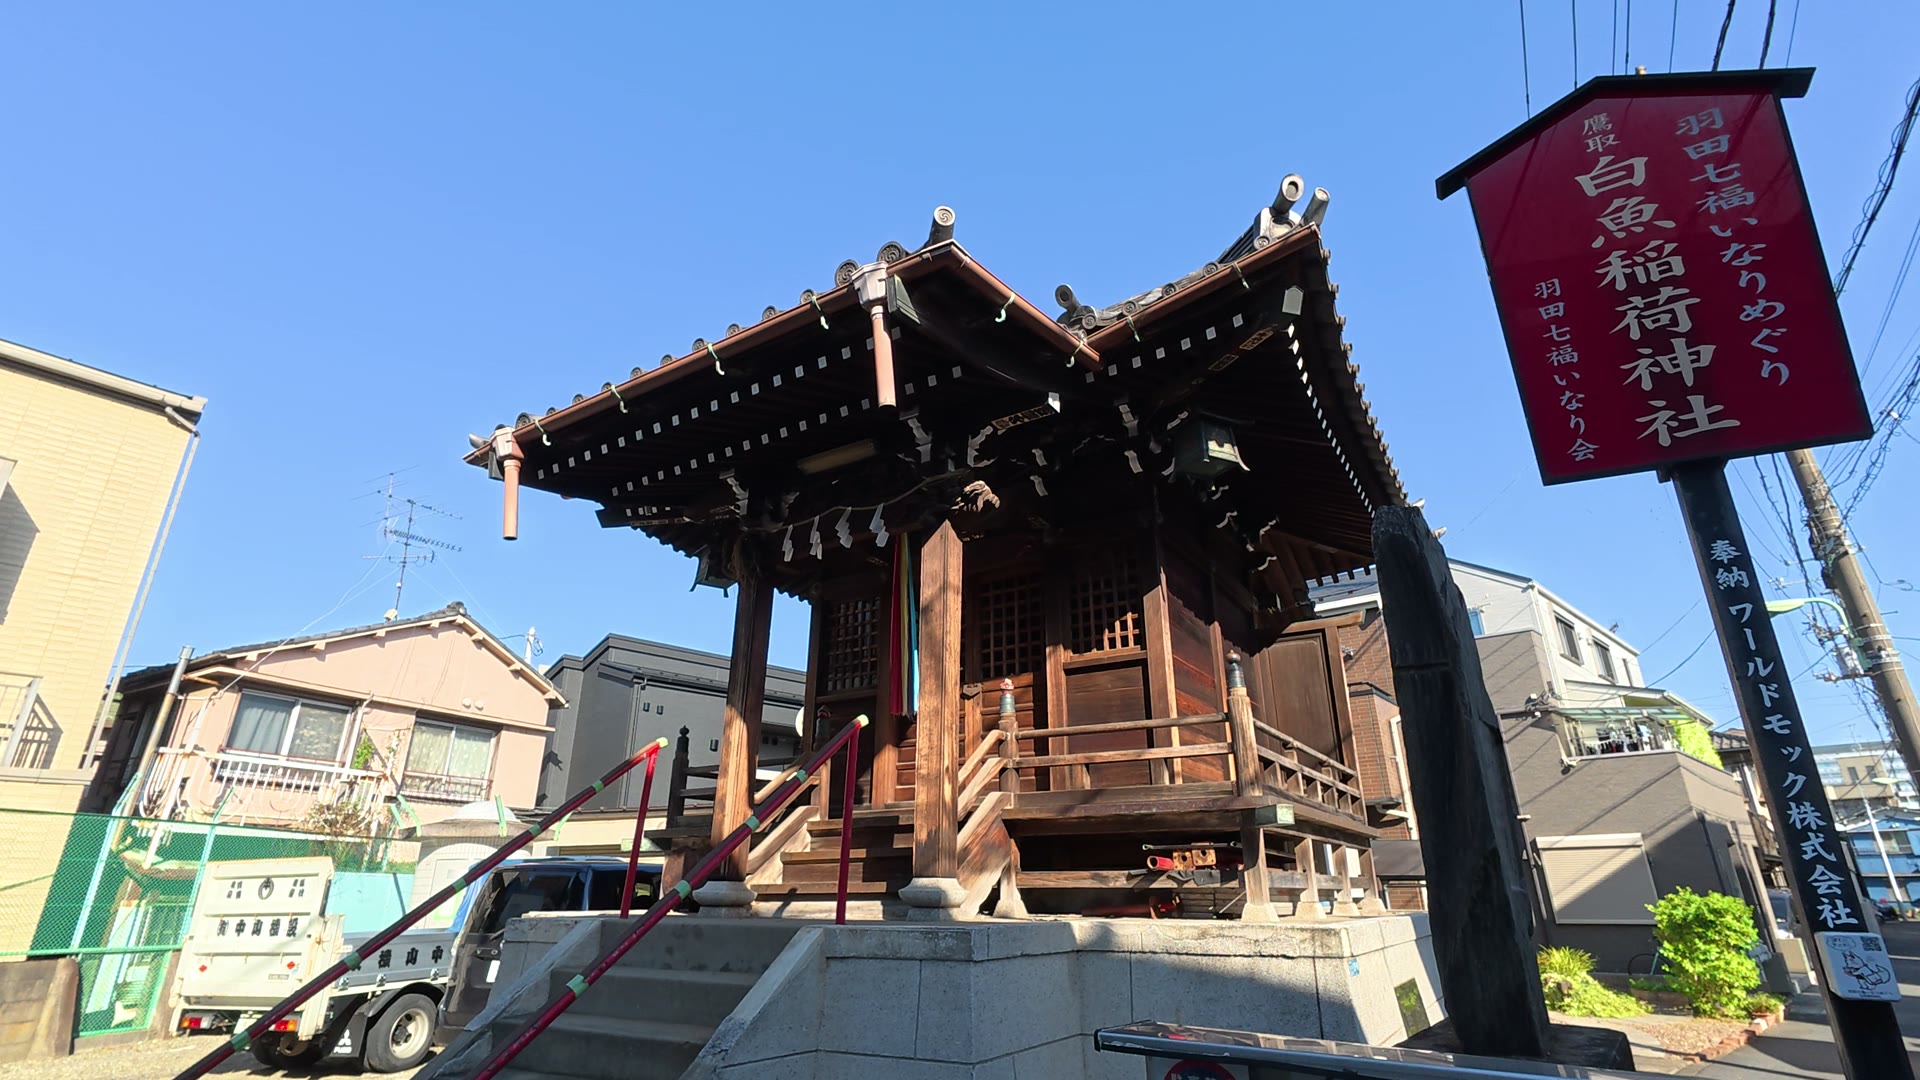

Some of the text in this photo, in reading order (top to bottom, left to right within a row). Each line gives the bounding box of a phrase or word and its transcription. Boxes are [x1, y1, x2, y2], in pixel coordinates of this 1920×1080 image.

[1534, 277, 1600, 461] 羽田七福いなり会
[1575, 113, 1741, 446] 鷹取 白魚稲荷神社
[1675, 107, 1790, 386] 羽田七福いなりめぐり
[1710, 539, 1859, 928] 奉納 ワールドモック株式会社
